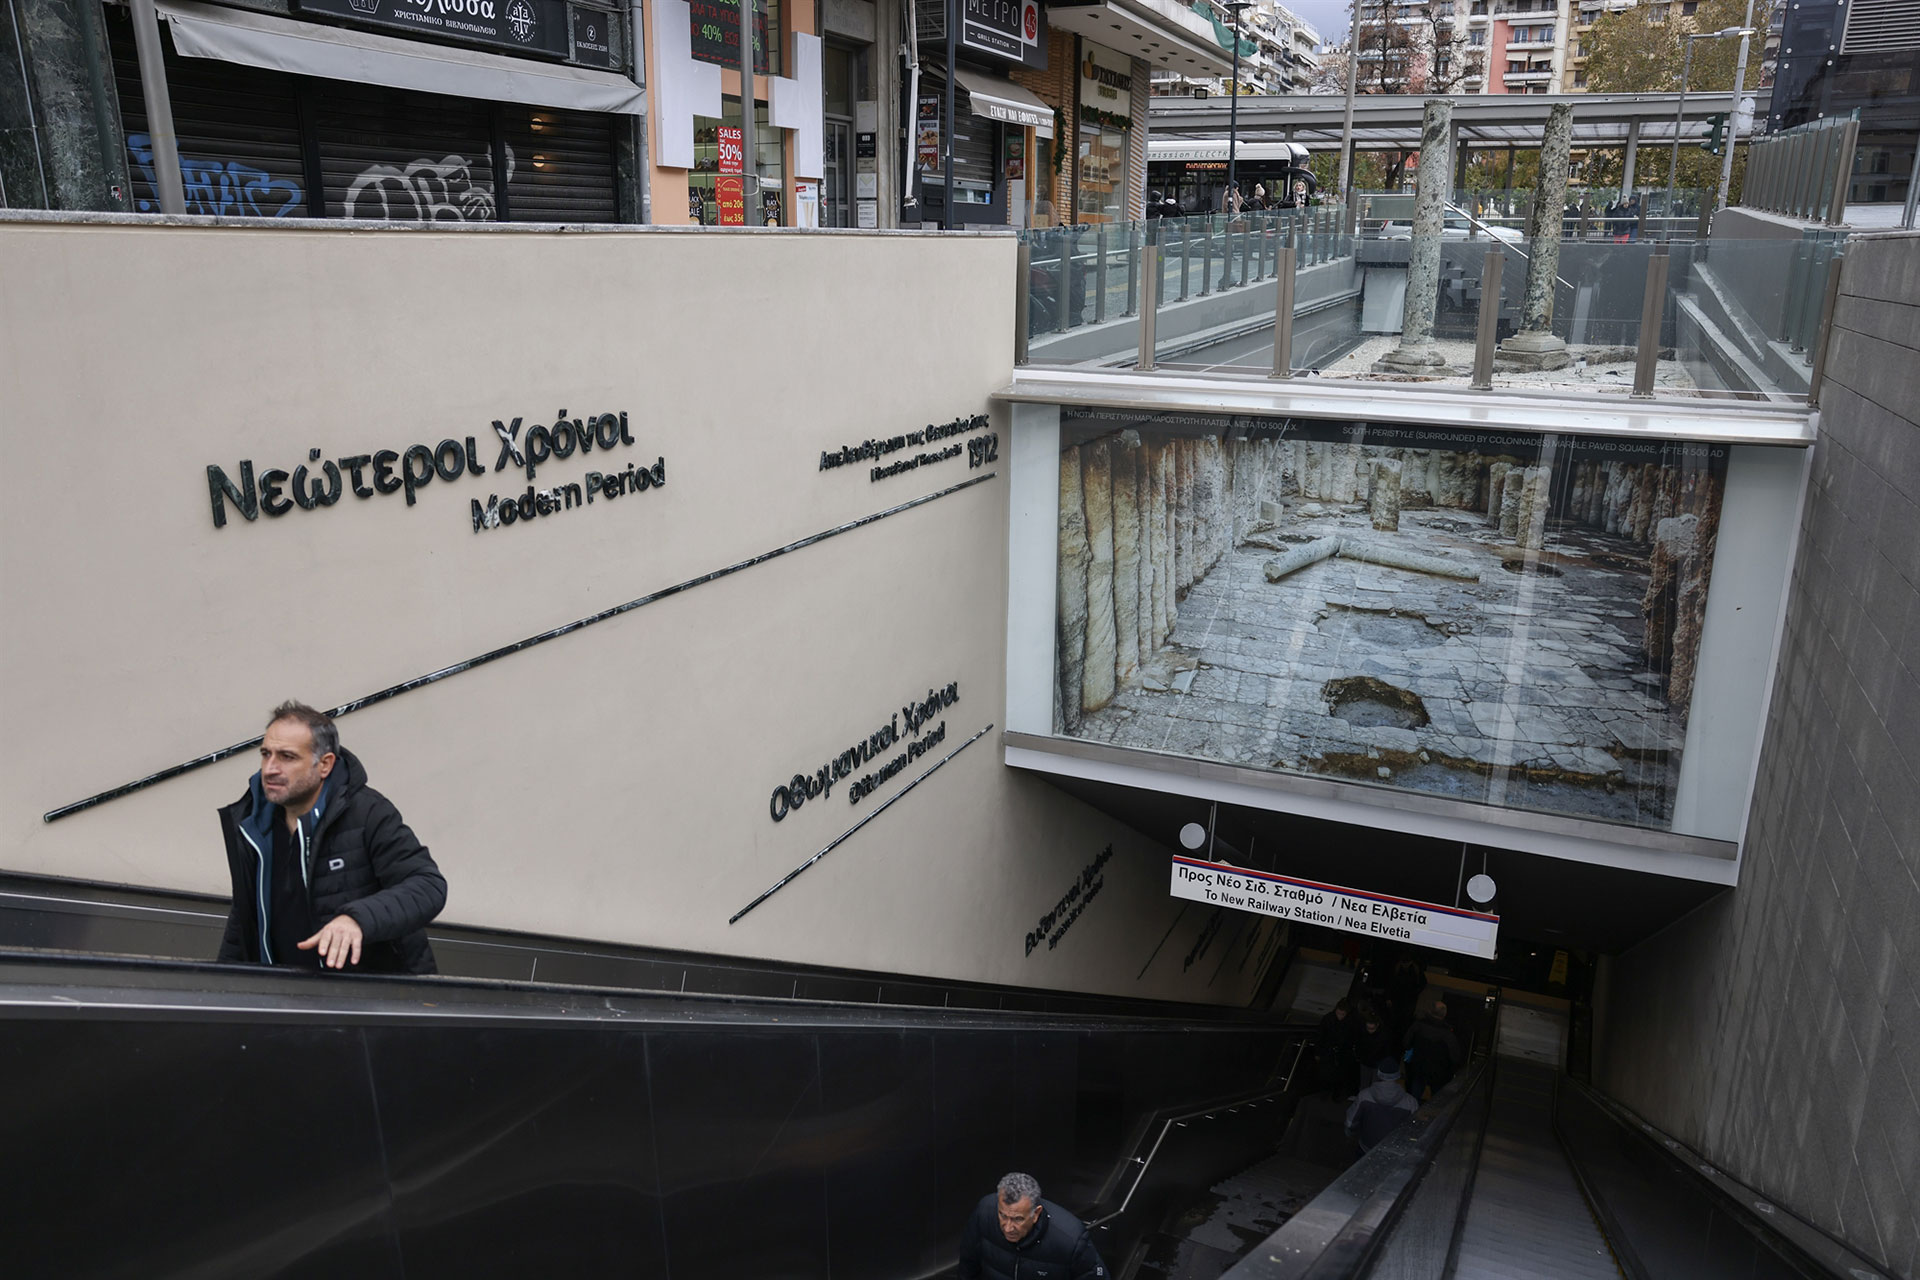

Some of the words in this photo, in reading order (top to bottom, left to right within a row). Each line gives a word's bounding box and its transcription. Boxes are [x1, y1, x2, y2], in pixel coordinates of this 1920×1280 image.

[701, 23, 722, 42] 40%
[1026, 13, 1037, 33] 43
[977, 32, 991, 43] GRILL
[991, 37, 1010, 48] STATION
[719, 128, 742, 140] SALES
[719, 143, 742, 161] 50%
[1194, 150, 1240, 158] ELECTRC
[1268, 422, 1283, 431] 500
[1342, 426, 1371, 436] SOUTH
[1372, 429, 1414, 439] PERISTYLE
[1416, 431, 1476, 443] (SURROUNDED
[1477, 435, 1488, 444] BY
[1551, 438, 1587, 450] MARBLE
[1588, 440, 1617, 452] PAVED
[1659, 445, 1689, 457] AFTER
[1690, 447, 1709, 457] 500
[1710, 448, 1725, 459] AD
[967, 432, 999, 470] 1912
[206, 436, 486, 529] Νεώτεροι
[490, 408, 635, 480] Χρόνοι
[471, 480, 583, 534] Modern
[585, 456, 666, 505] Period
[770, 712, 900, 822] Οθωμανικοί
[901, 681, 960, 738] Χρόνοι
[849, 752, 907, 805] Ottoman
[907, 720, 946, 765] Period
[1179, 866, 1213, 886] Προς
[1216, 873, 1242, 889] Νέο
[1245, 879, 1269, 895] Σιδ.
[1274, 885, 1323, 905] Σταθμό
[1331, 896, 1338, 907] /
[1341, 897, 1368, 914] Νεα
[1372, 904, 1427, 925] Ελβετία
[1205, 889, 1218, 901] To
[1221, 892, 1245, 906] New
[1247, 897, 1291, 917] Railway
[1294, 906, 1334, 924] Station
[1345, 917, 1367, 930] Nea
[1371, 921, 1411, 939] Elvetia
